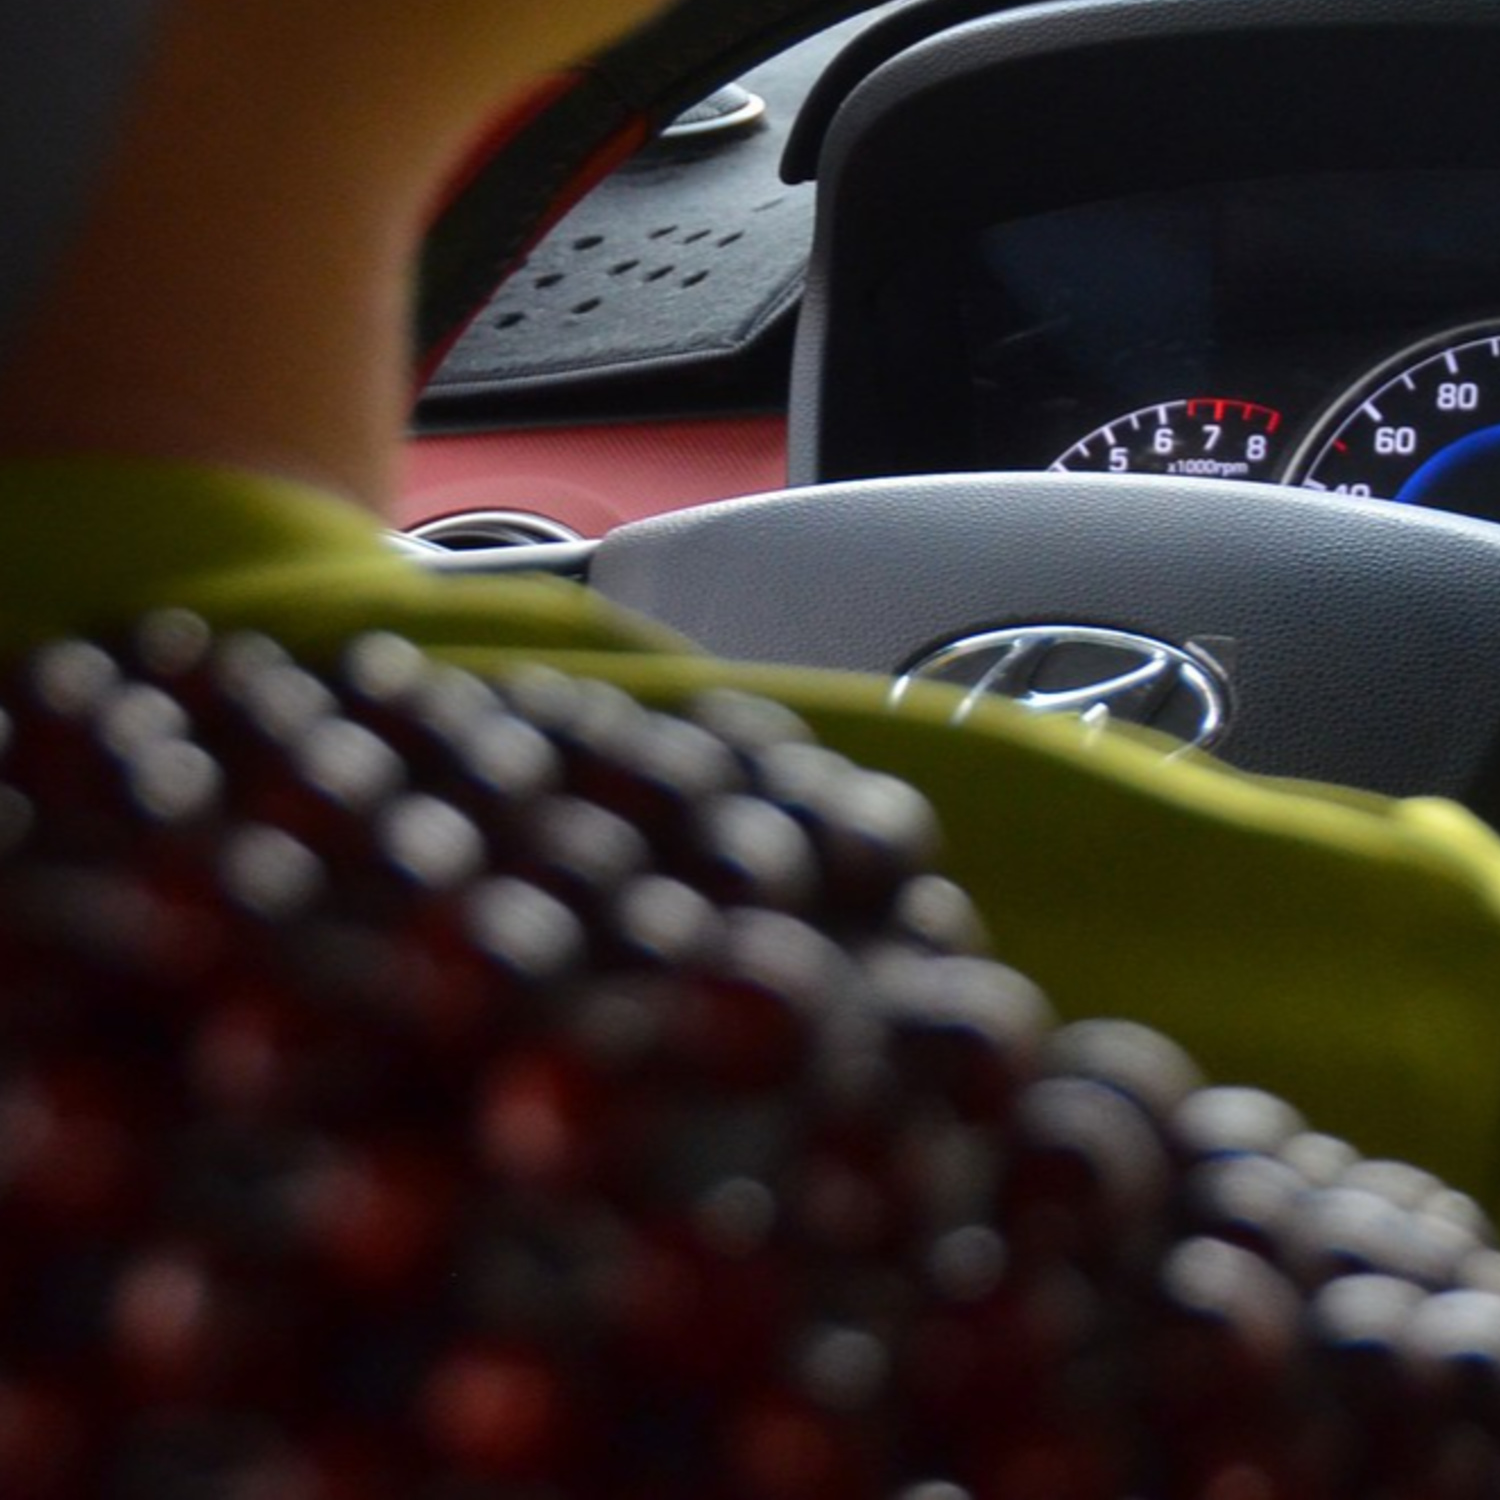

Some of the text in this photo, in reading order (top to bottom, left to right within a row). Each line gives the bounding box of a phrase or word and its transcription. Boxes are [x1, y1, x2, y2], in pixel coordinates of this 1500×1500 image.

[1436, 383, 1479, 410] 80
[1153, 428, 1174, 454] 6
[1203, 425, 1221, 450] 7
[1246, 434, 1266, 460] 8
[1374, 426, 1416, 454] 60
[1108, 447, 1128, 472] 5
[1167, 459, 1248, 477] x1000rpm
